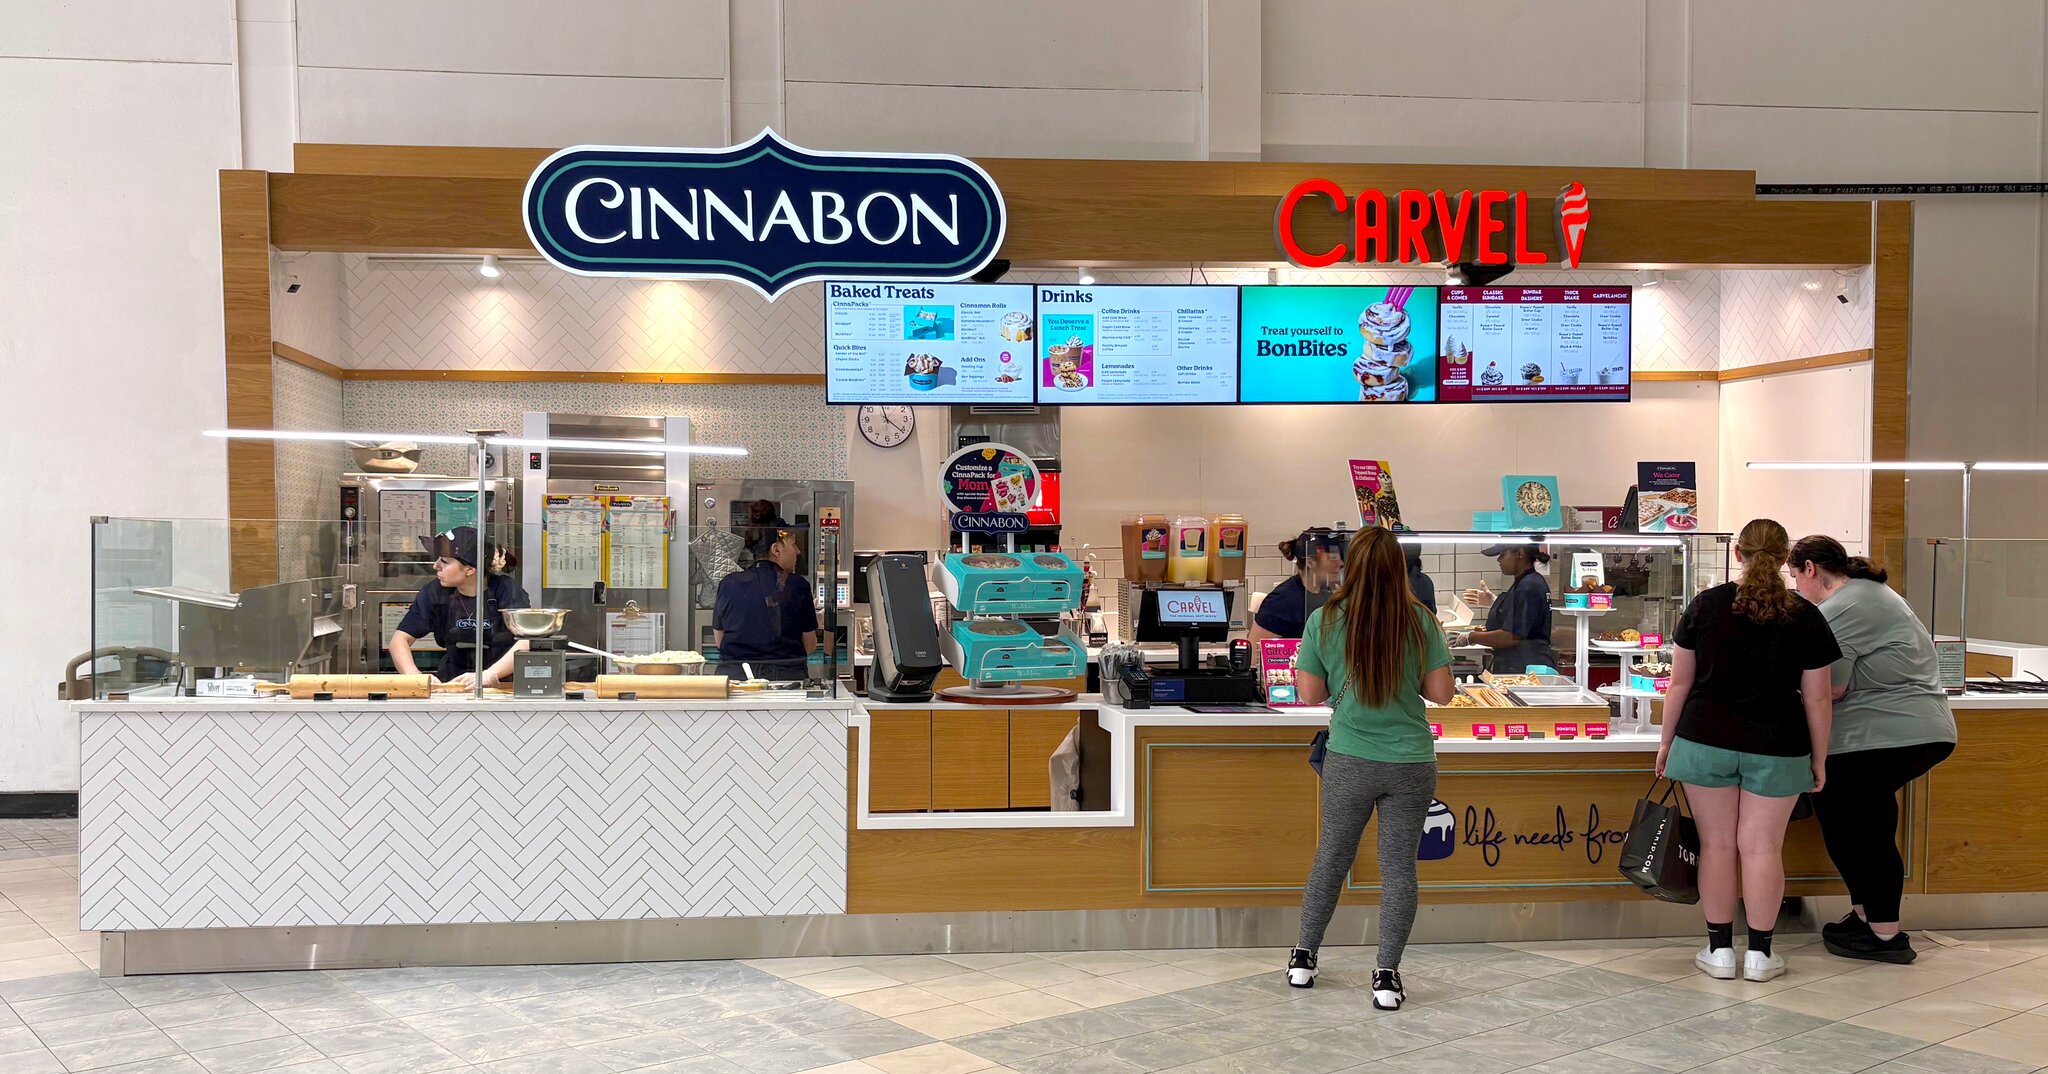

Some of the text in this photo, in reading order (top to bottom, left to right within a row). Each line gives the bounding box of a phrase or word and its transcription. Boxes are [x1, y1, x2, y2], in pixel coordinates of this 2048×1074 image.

[564, 177, 960, 246] CINNABON
[1277, 178, 1548, 268] CARVEL
[830, 284, 934, 299] Baked Treats
[1042, 290, 1092, 302] Drinks
[1261, 326, 1343, 337] Treat yourself to
[958, 479, 989, 490] Mom
[958, 515, 1024, 528] CINNABON
[1167, 595, 1216, 613] CARVEL
[1462, 805, 1506, 868] life
[1514, 805, 1574, 852] needs
